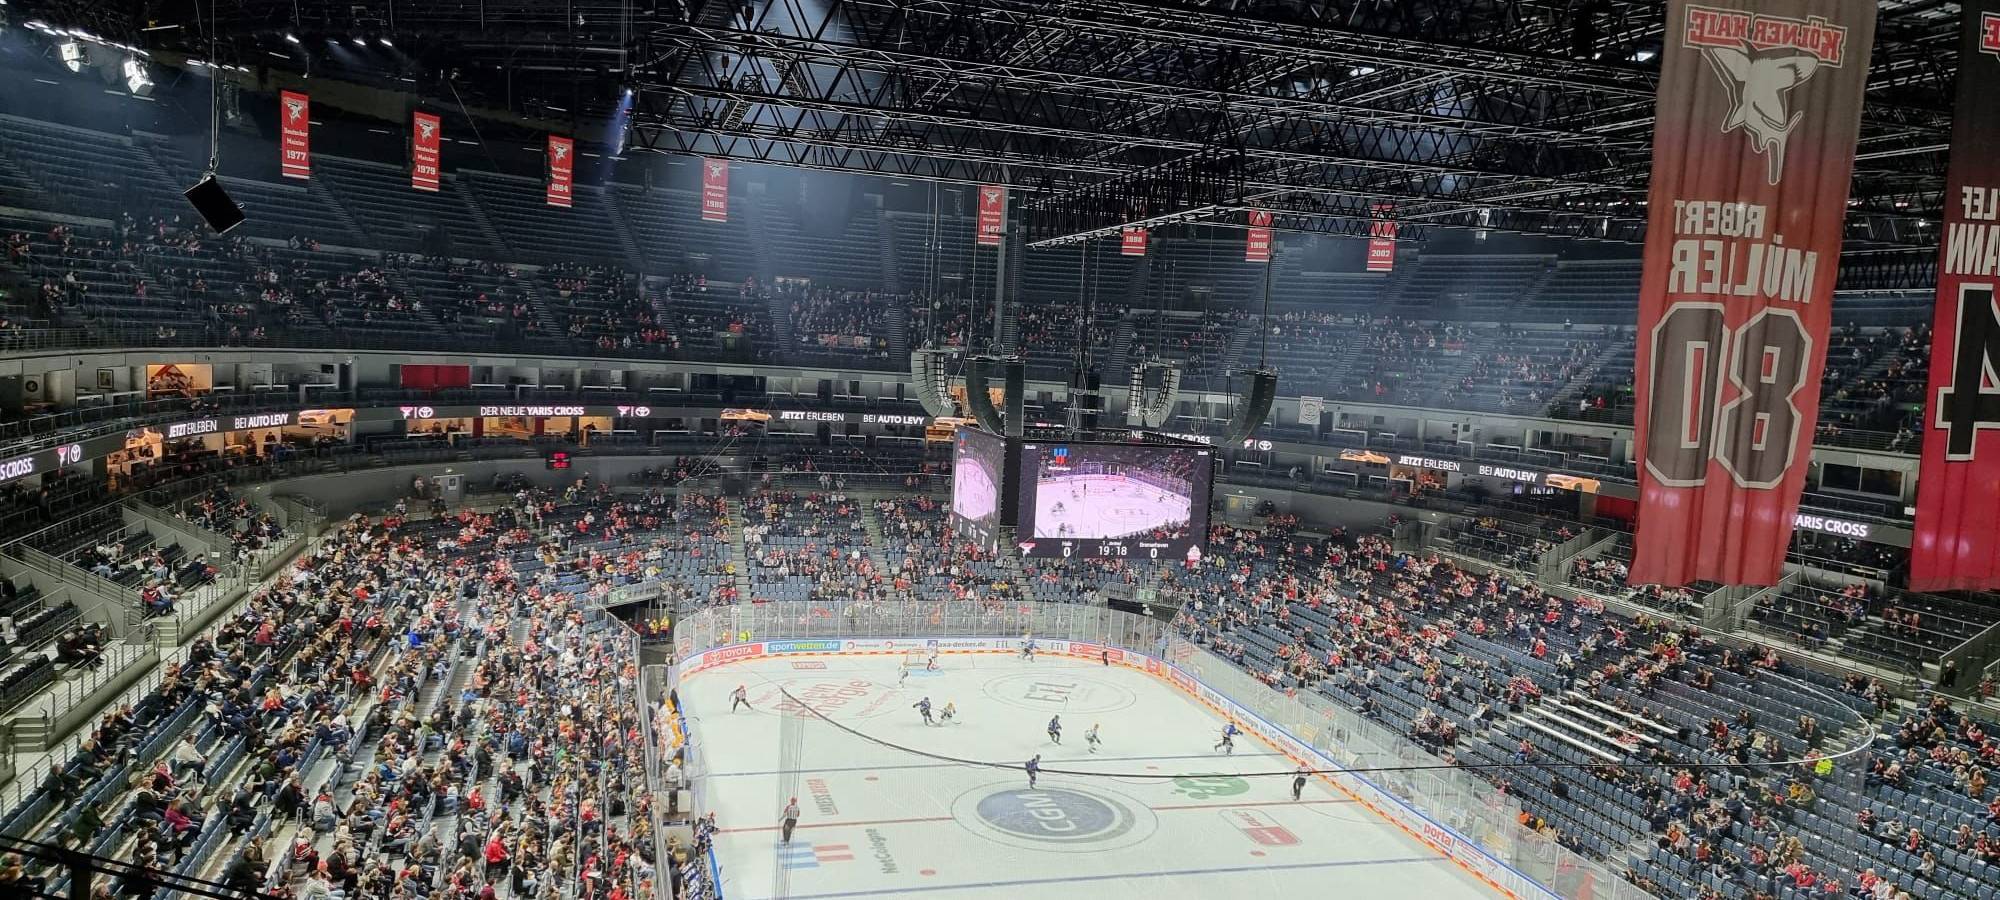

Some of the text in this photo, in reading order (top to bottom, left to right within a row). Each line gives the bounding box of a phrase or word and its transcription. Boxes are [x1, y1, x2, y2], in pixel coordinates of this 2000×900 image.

[286, 137, 305, 147] Meister
[286, 149, 306, 161] 1977
[417, 164, 436, 175] 1979
[1371, 249, 1391, 257] 2002
[480, 406, 584, 416] DER NEUE YARIS CROSS
[780, 411, 844, 422] JETZT ERLEBEN
[234, 413, 289, 430] BEI AUTO LEVY
[863, 413, 925, 425] BEI AUTO LEVY
[168, 419, 217, 438] JETZT ERLEBEN
[6, 458, 33, 479] CROSS
[1398, 455, 1460, 472] JETZT ERLEBEN
[1479, 465, 1538, 483] BEI AUTO LEVY
[1794, 514, 1868, 537] ARIS CROSS
[1063, 547, 1071, 558] 0
[1099, 546, 1128, 556] 19:18
[1150, 548, 1158, 559] 0
[723, 645, 753, 659] TOYOTA
[769, 641, 839, 652] sportwetten.de
[1015, 792, 1077, 833] CGM
